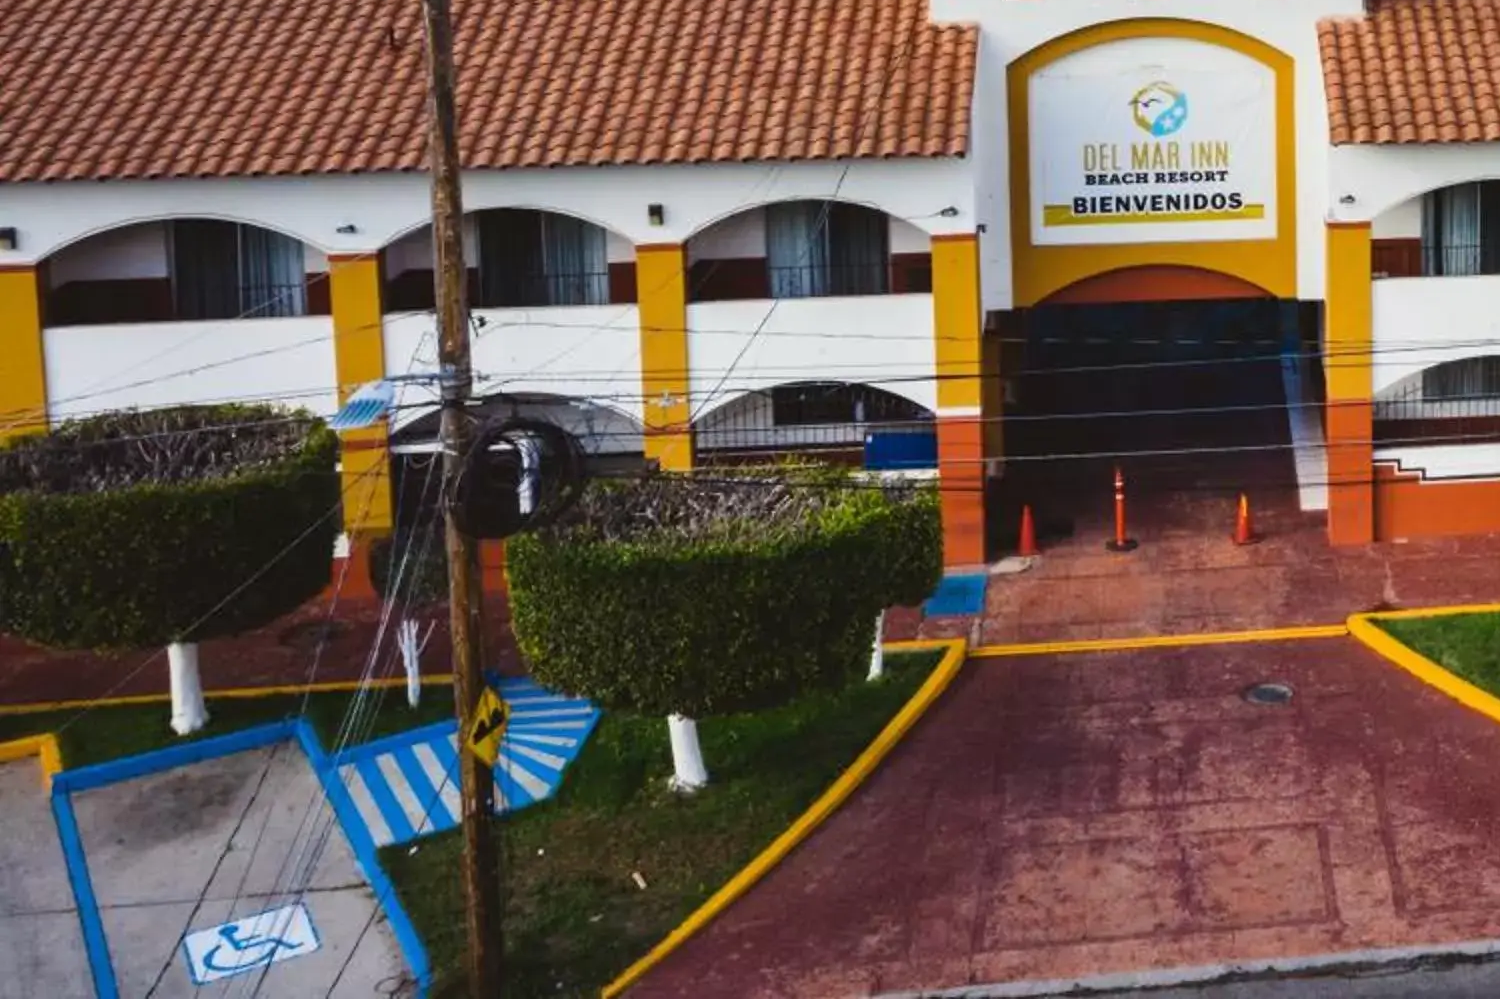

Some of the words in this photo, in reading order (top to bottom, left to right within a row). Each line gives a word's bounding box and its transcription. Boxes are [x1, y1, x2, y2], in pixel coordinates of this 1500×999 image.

[1083, 143, 1121, 172] DEL
[1131, 142, 1180, 171] MAR
[1191, 141, 1229, 169] INN
[1085, 172, 1149, 186] BEACH
[1154, 170, 1229, 184] RESORT
[1073, 192, 1243, 214] BIENVENIDOS
